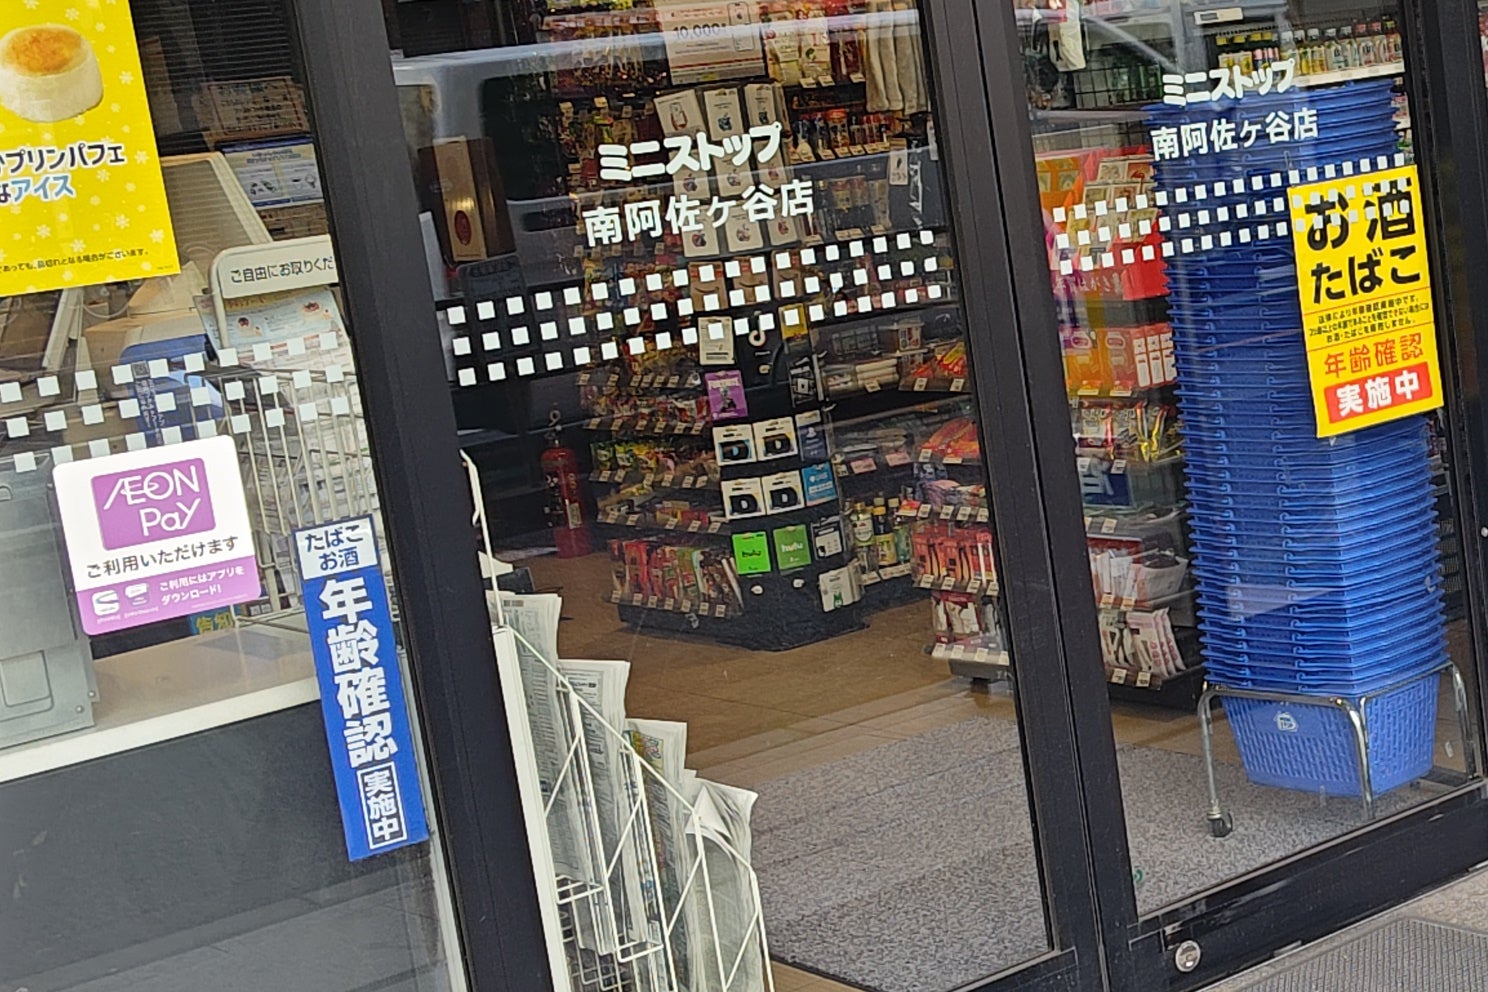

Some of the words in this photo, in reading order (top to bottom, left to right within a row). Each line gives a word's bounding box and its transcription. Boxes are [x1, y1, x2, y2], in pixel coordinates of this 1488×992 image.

[1163, 58, 1295, 107] ミニストップ
[0, 142, 126, 174] プリンパフェ
[598, 121, 783, 182] ミニストップ
[1305, 179, 1416, 251] お酒
[1311, 246, 1421, 304] たばこ
[1324, 332, 1423, 378] 年齢確認
[1336, 369, 1420, 417] 実施中
[139, 497, 201, 537] Pay
[304, 524, 364, 552] たばこ
[86, 535, 239, 579] ご利用いただけます
[159, 565, 246, 591] ご利用にはアプリを
[318, 546, 360, 571] お酒
[319, 577, 399, 768] 年齢確認
[363, 769, 401, 841] 実施中
